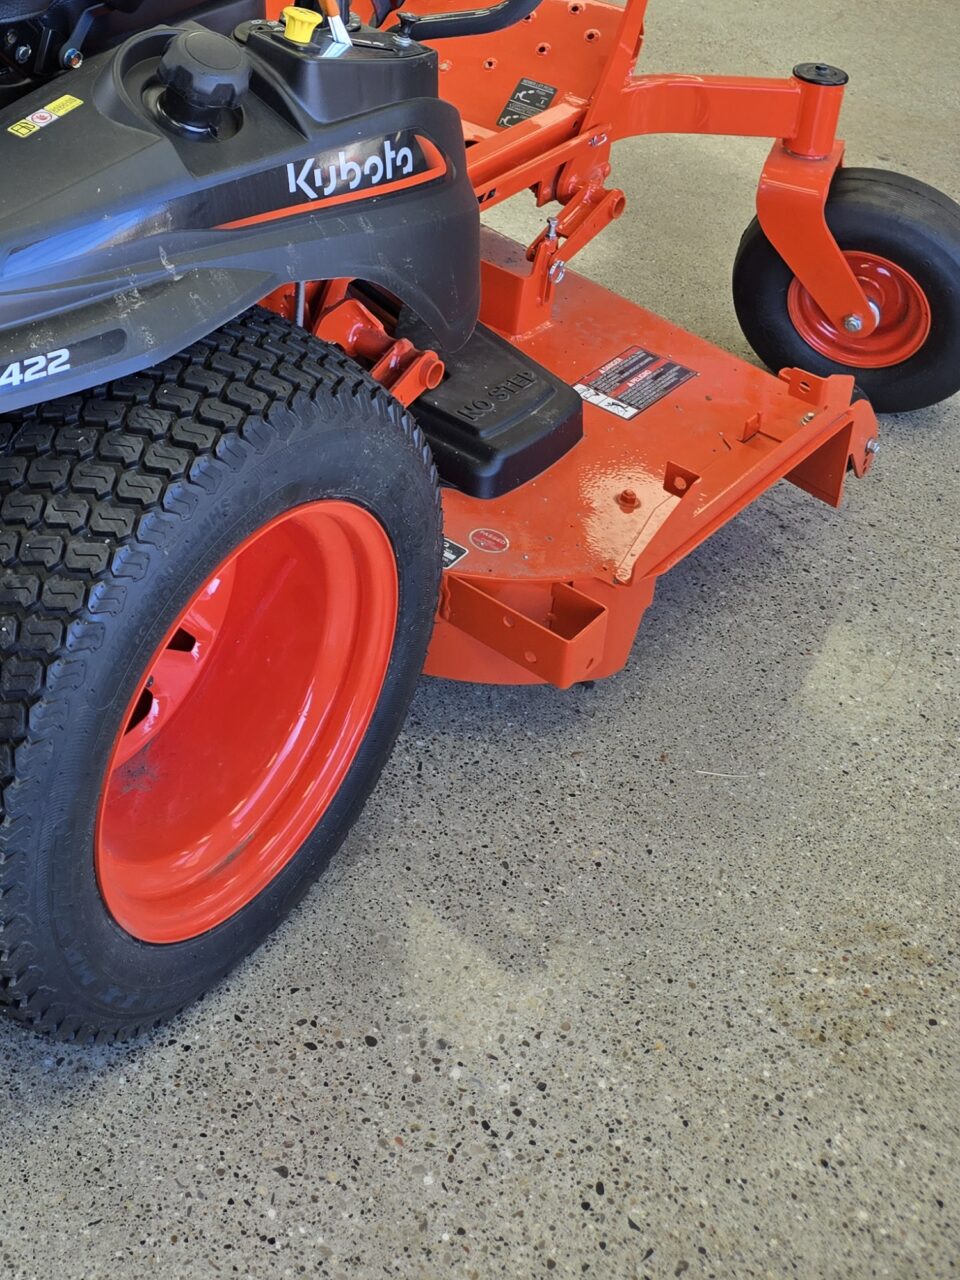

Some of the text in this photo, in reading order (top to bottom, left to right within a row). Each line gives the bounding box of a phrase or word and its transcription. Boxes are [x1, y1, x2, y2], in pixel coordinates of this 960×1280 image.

[287, 140, 413, 199] Kubota
[456, 371, 536, 422] NO STEP
